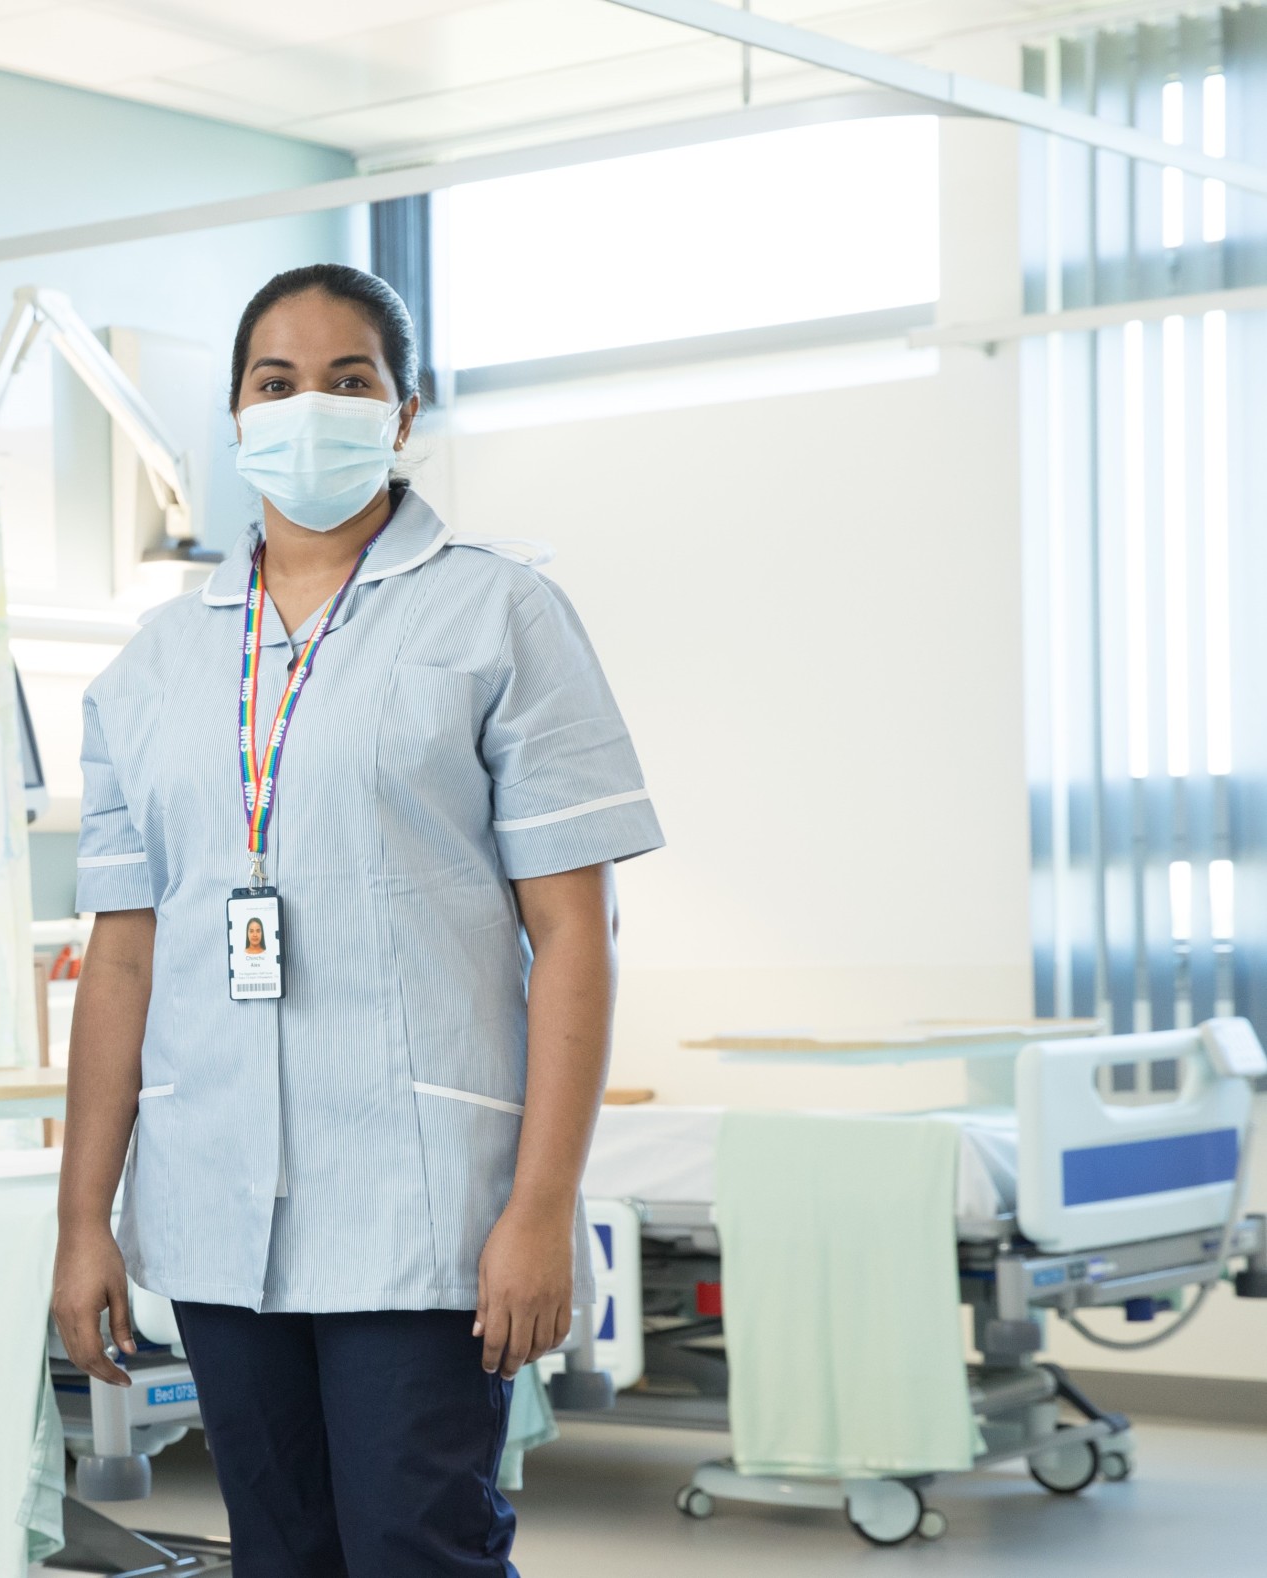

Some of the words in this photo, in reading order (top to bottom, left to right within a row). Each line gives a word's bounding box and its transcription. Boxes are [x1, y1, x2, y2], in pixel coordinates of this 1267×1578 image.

[249, 588, 262, 610] NHS
[311, 617, 329, 641] NHS
[244, 632, 258, 655] NHS
[241, 677, 254, 702] NHS
[289, 666, 307, 693] NHS
[240, 725, 253, 752] NHS
[270, 718, 287, 748] NHS
[257, 776, 273, 809] NHS
[154, 1386, 175, 1403] Bed
